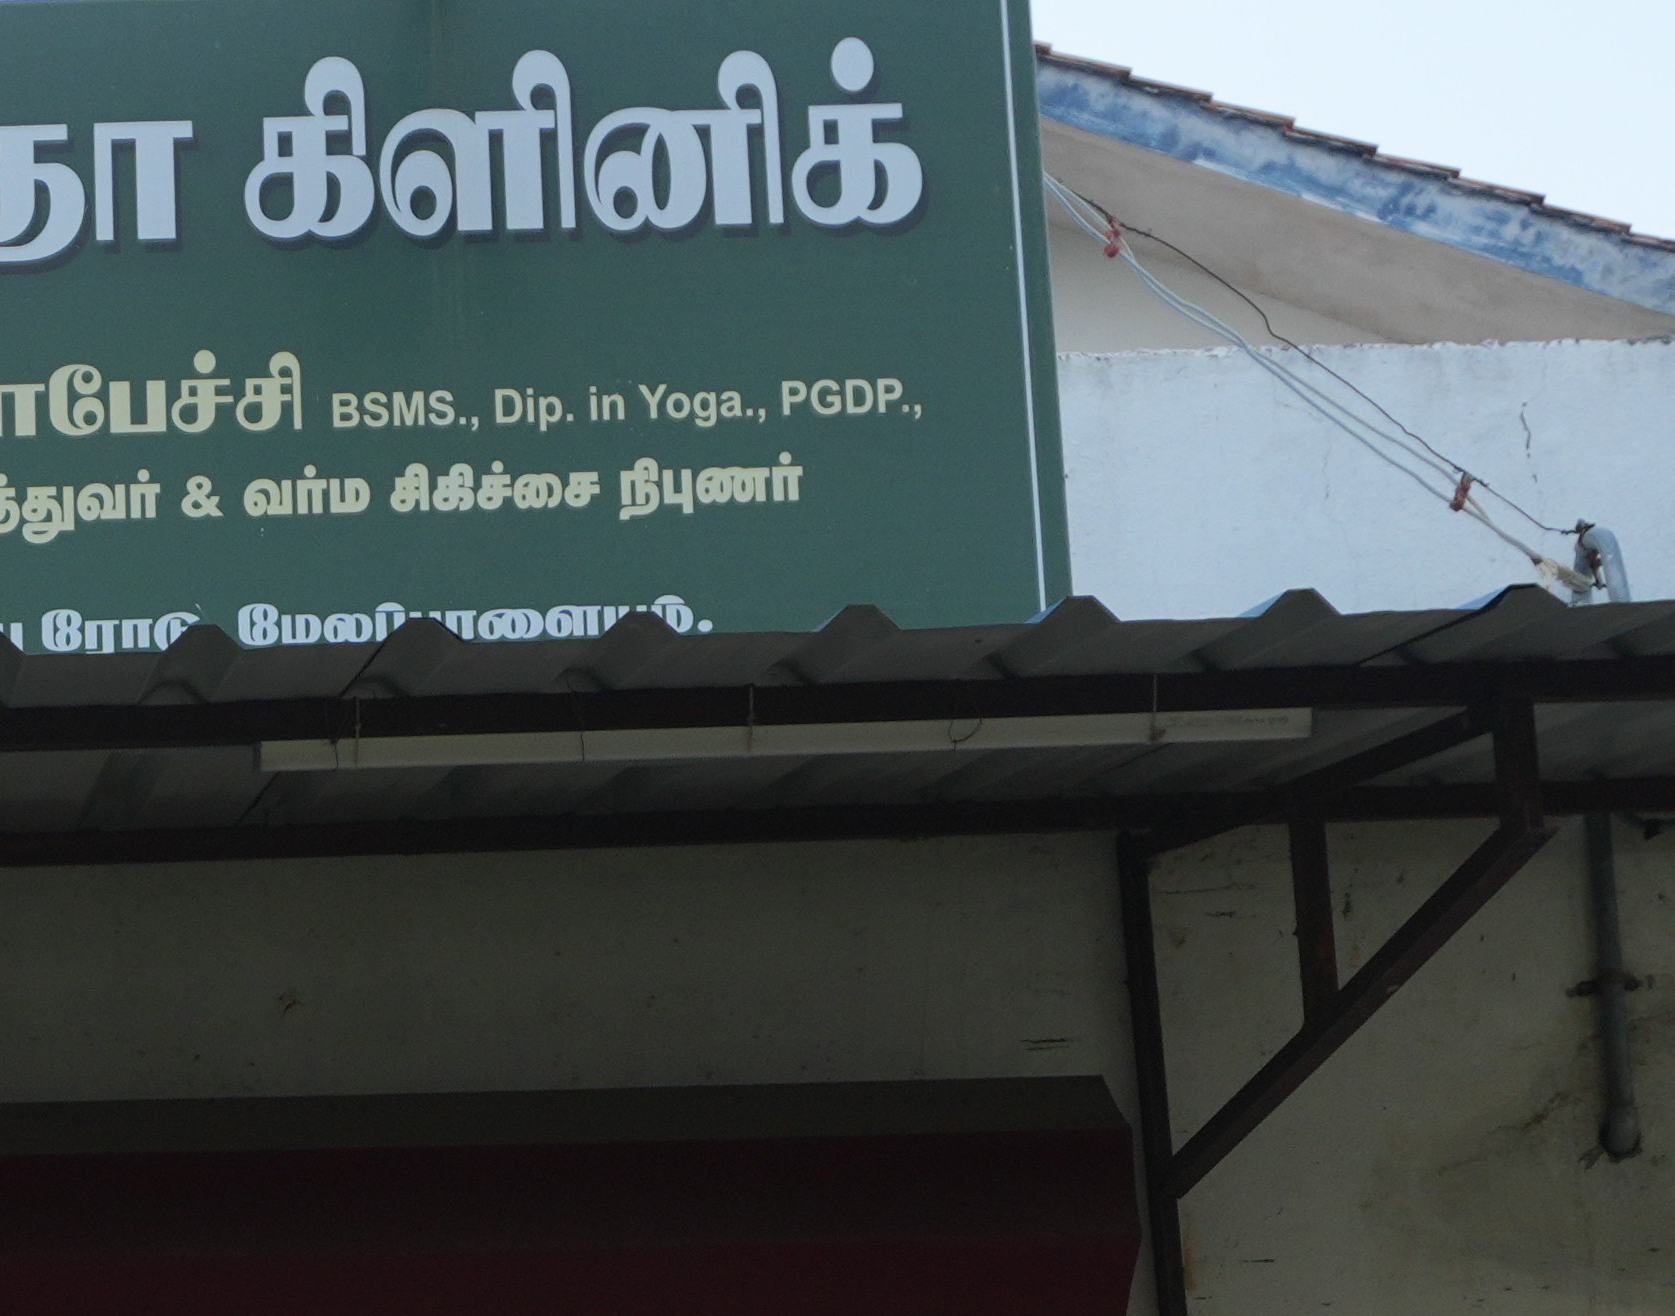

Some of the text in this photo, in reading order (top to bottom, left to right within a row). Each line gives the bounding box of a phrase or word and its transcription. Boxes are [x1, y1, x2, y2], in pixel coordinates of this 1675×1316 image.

[245, 37, 922, 238] கிளினிக்
[333, 390, 478, 431] BSMS.,
[495, 388, 573, 431] Dip.
[590, 386, 624, 420] in
[639, 384, 765, 427] Yoga.,
[782, 378, 921, 419] PGDP.,
[181, 476, 223, 517] &
[244, 465, 370, 517] வர்ம
[390, 461, 600, 512] சிகிச்சை
[620, 452, 803, 520] நிபுணர்
